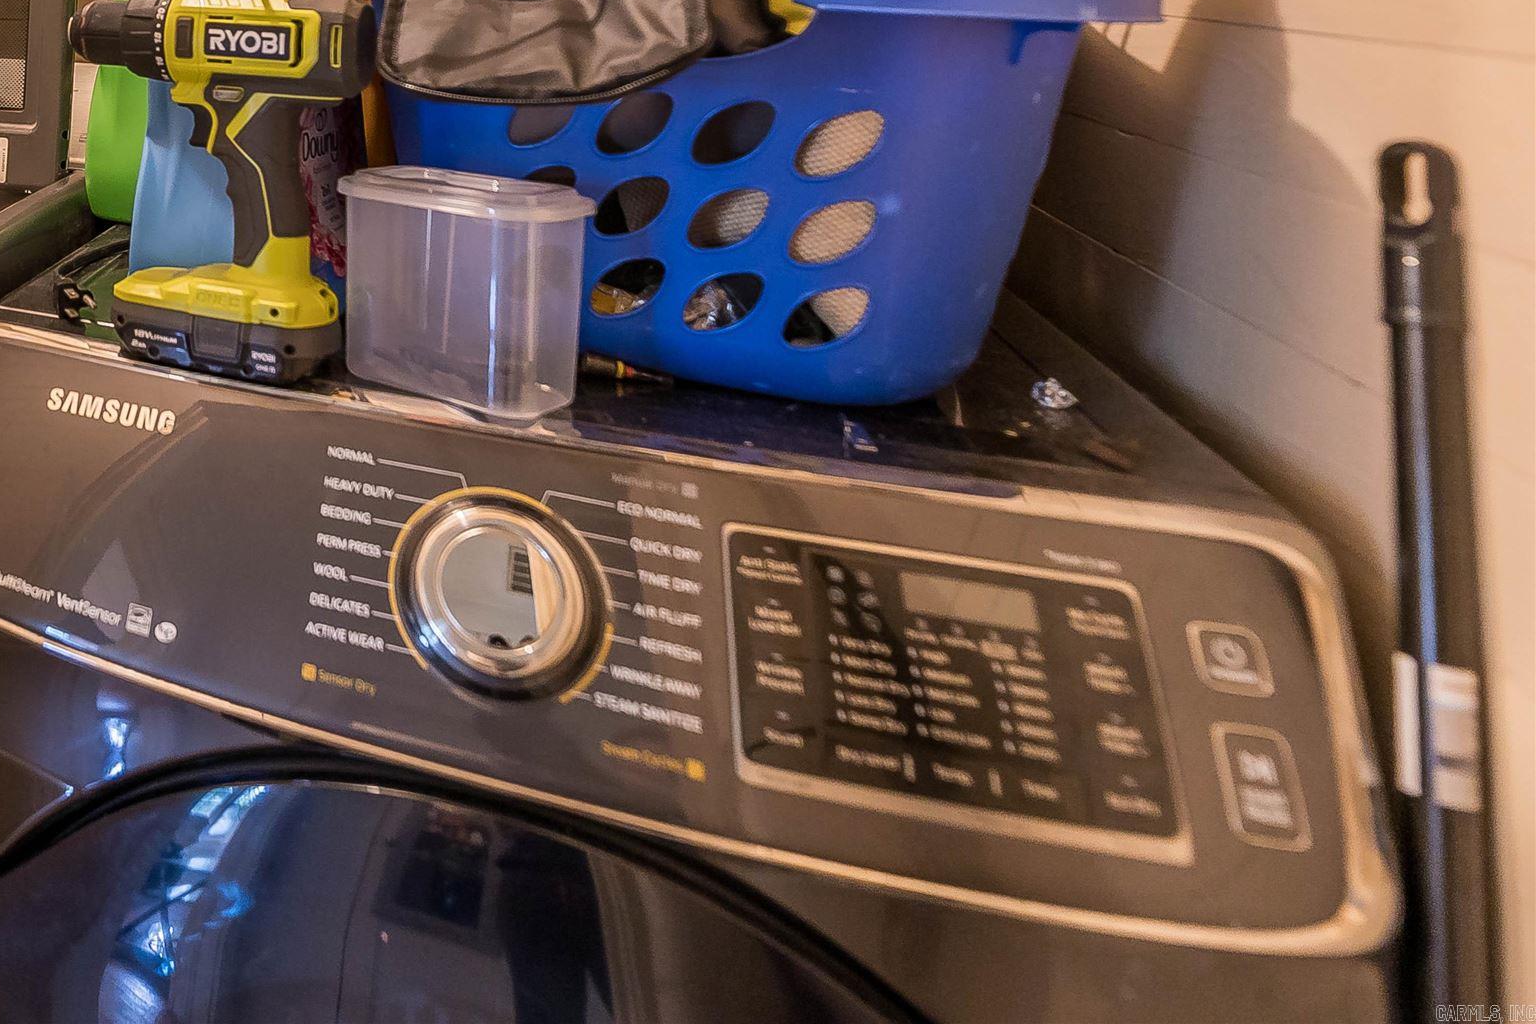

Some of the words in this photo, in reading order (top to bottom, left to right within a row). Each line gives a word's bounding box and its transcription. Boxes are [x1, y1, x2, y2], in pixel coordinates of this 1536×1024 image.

[207, 28, 286, 56] RYOBI
[302, 131, 338, 163] Downy
[47, 387, 176, 435] SAMSUNG
[327, 445, 376, 466] NORMAL
[323, 475, 362, 494] HEAVY
[362, 483, 395, 500] DUTY
[320, 503, 372, 526] BEDDING
[617, 500, 644, 517] ECO
[644, 505, 703, 530] NORMAL
[316, 532, 347, 551] PERM
[348, 539, 382, 559] PRESS
[630, 536, 672, 558] QUICK
[313, 561, 349, 582] WOOL
[309, 591, 370, 618] DELICATES
[305, 620, 347, 644] ACTIVE
[348, 630, 384, 652] WEAR
